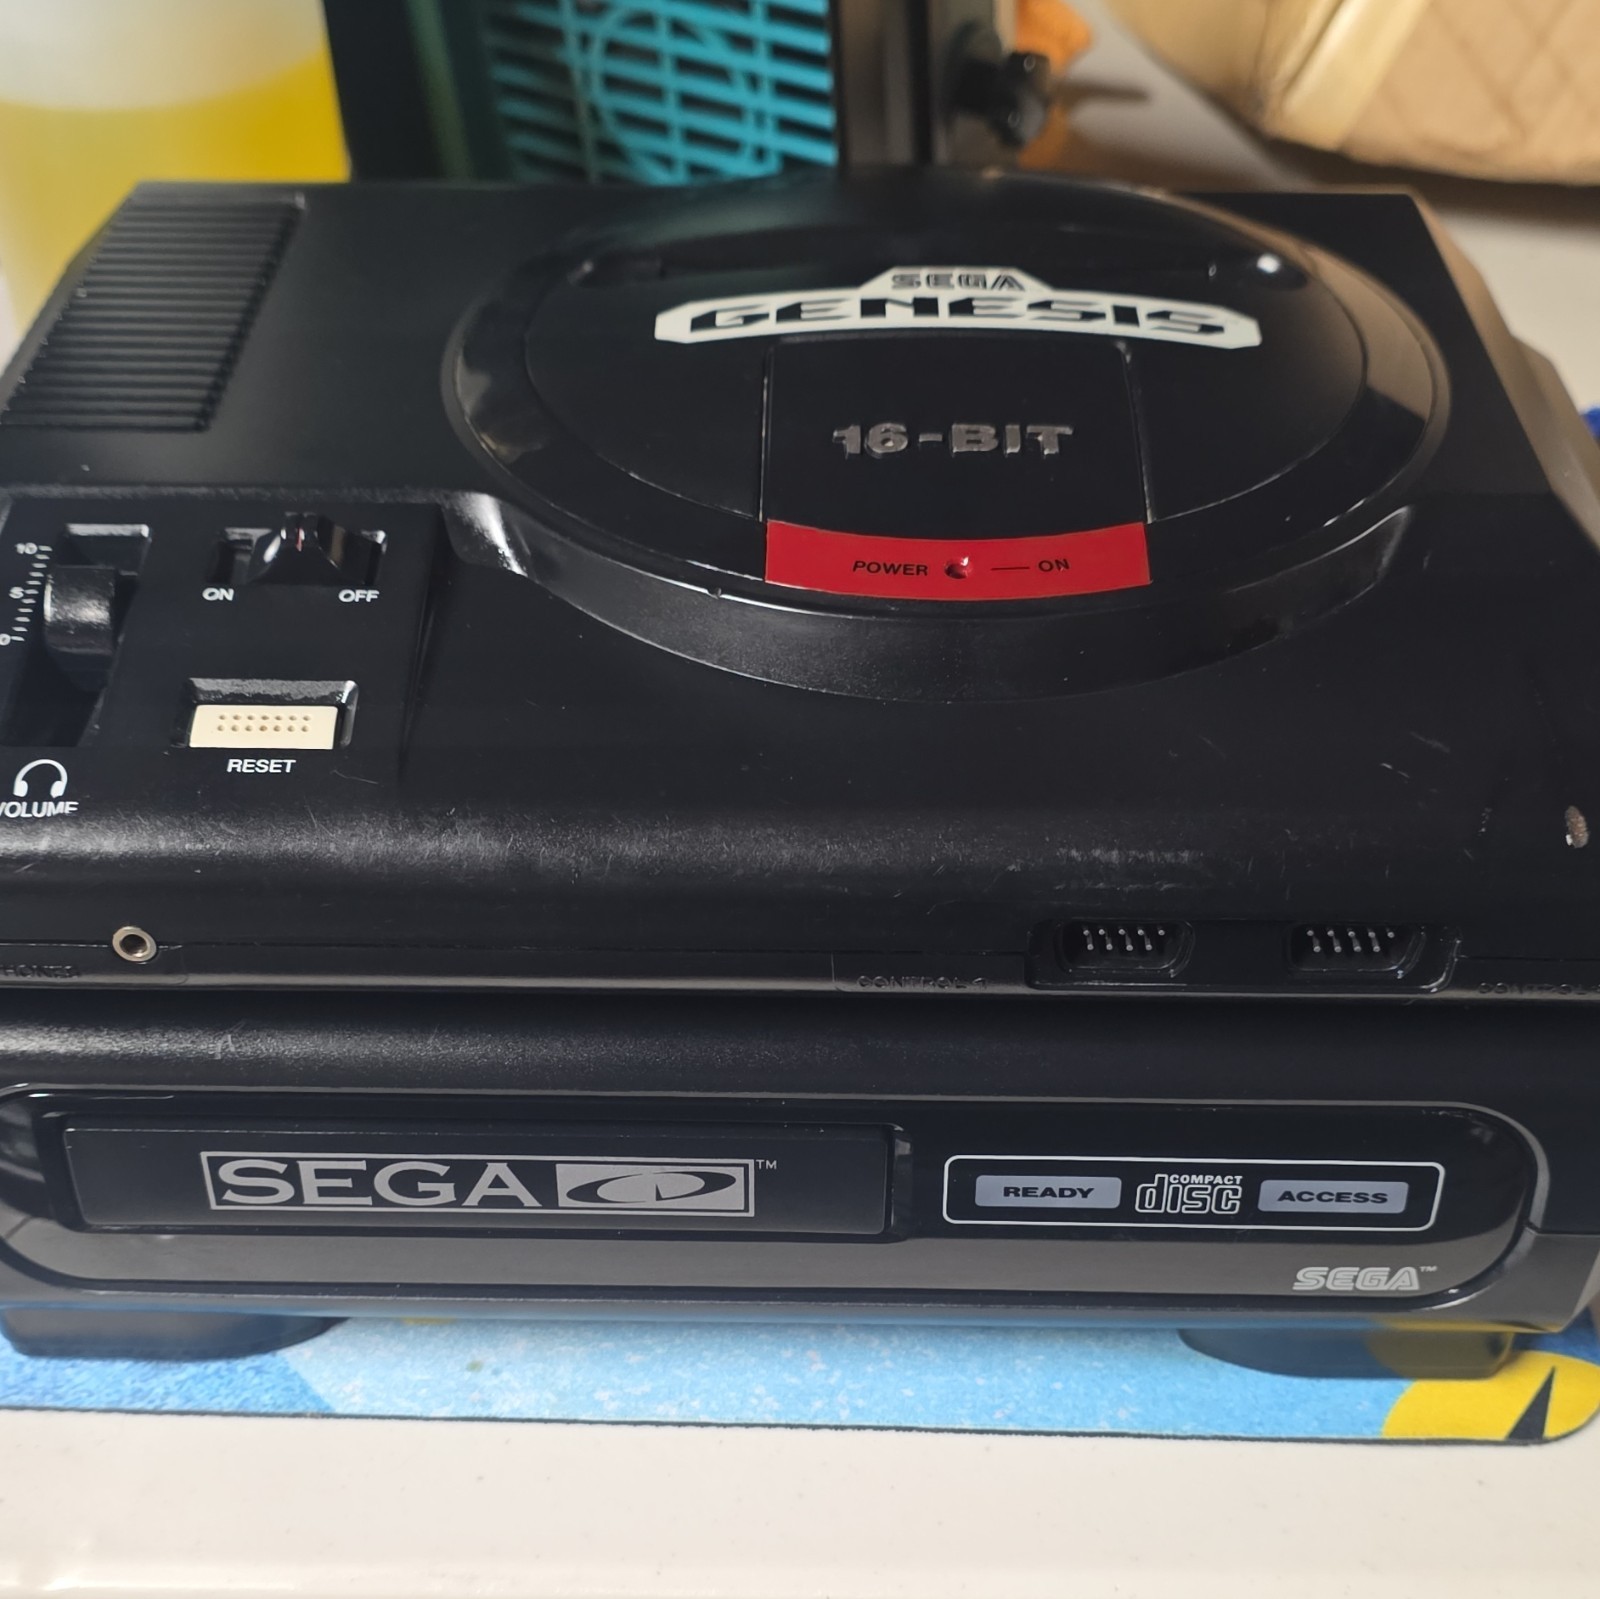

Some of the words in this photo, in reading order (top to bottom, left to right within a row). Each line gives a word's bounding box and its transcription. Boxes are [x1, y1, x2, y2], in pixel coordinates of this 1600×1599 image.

[891, 273, 1027, 292] SEGA
[690, 295, 1226, 336] GENESIS
[832, 422, 1075, 460] 16-BIT
[15, 542, 38, 555] 10
[852, 560, 929, 577] POWER
[1038, 557, 1070, 573] ON
[202, 587, 235, 602] ON
[338, 588, 380, 604] OFF
[226, 758, 297, 775] RESET
[216, 1158, 543, 1208] SEGA
[1168, 1173, 1243, 1186] COMPACT
[1003, 1185, 1095, 1200] READY
[1277, 1189, 1389, 1204] ACCESS
[1292, 1265, 1420, 1292] SEGA
